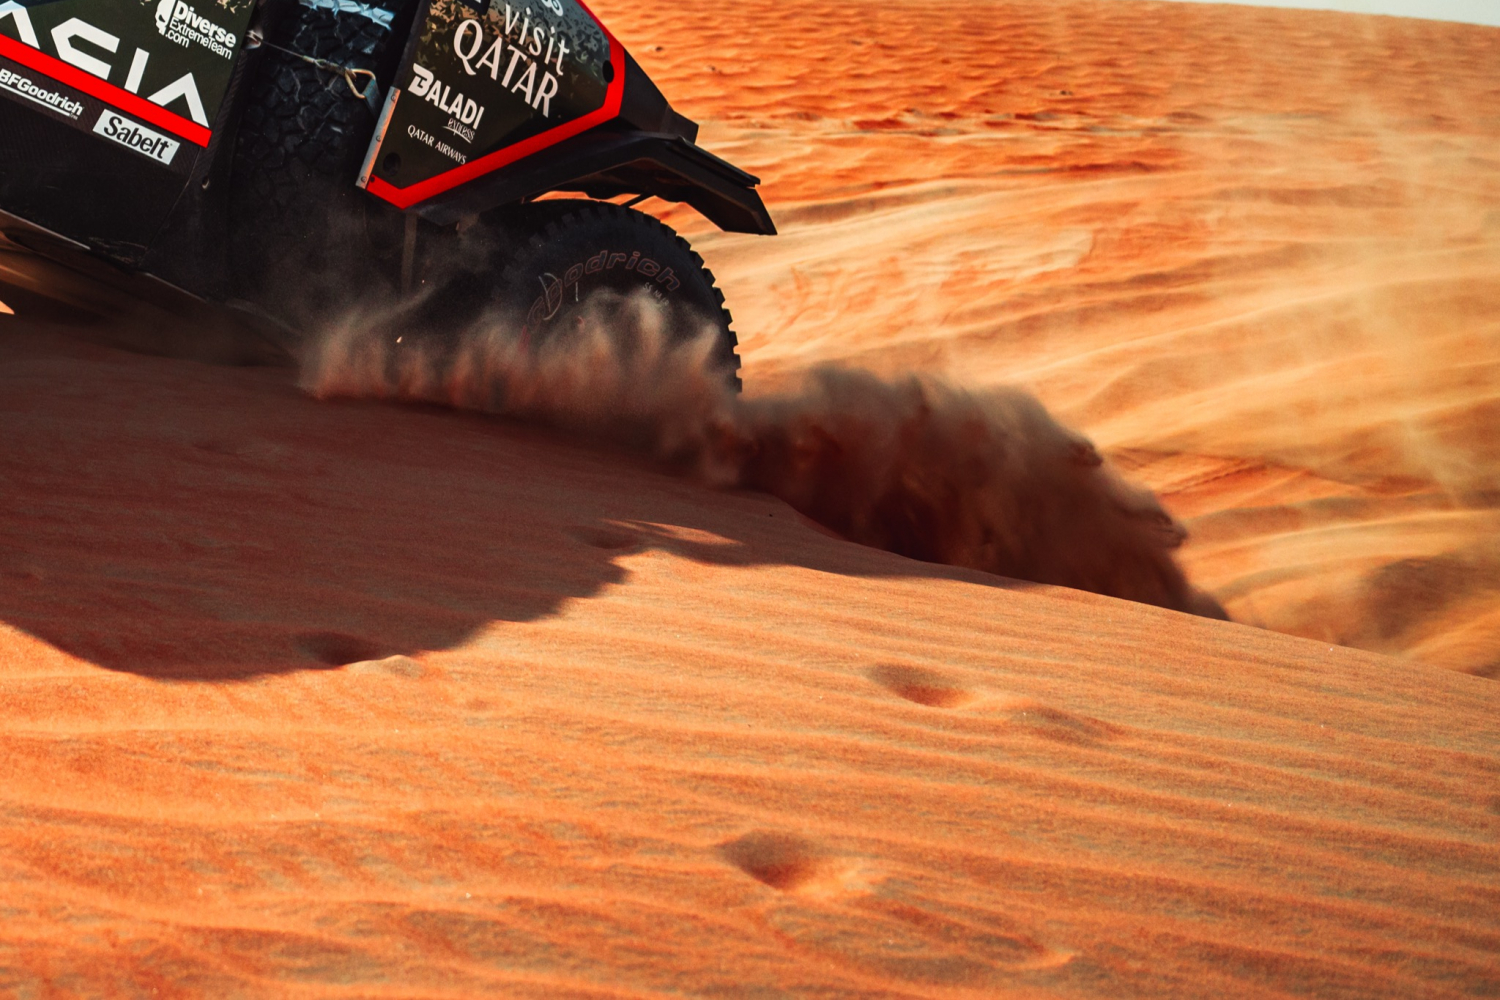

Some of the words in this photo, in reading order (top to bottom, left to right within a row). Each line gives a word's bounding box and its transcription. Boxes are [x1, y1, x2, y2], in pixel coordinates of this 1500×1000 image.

[165, 28, 190, 48] .com
[169, 17, 232, 60] ExtremeTeam
[174, 0, 237, 48] Diverse
[505, 4, 570, 76] visit
[454, 19, 559, 118] QATAR
[407, 63, 485, 130] BALADI
[104, 115, 170, 159] Sabelt
[407, 124, 435, 147] QATAR
[435, 141, 467, 165] AIRWAYS
